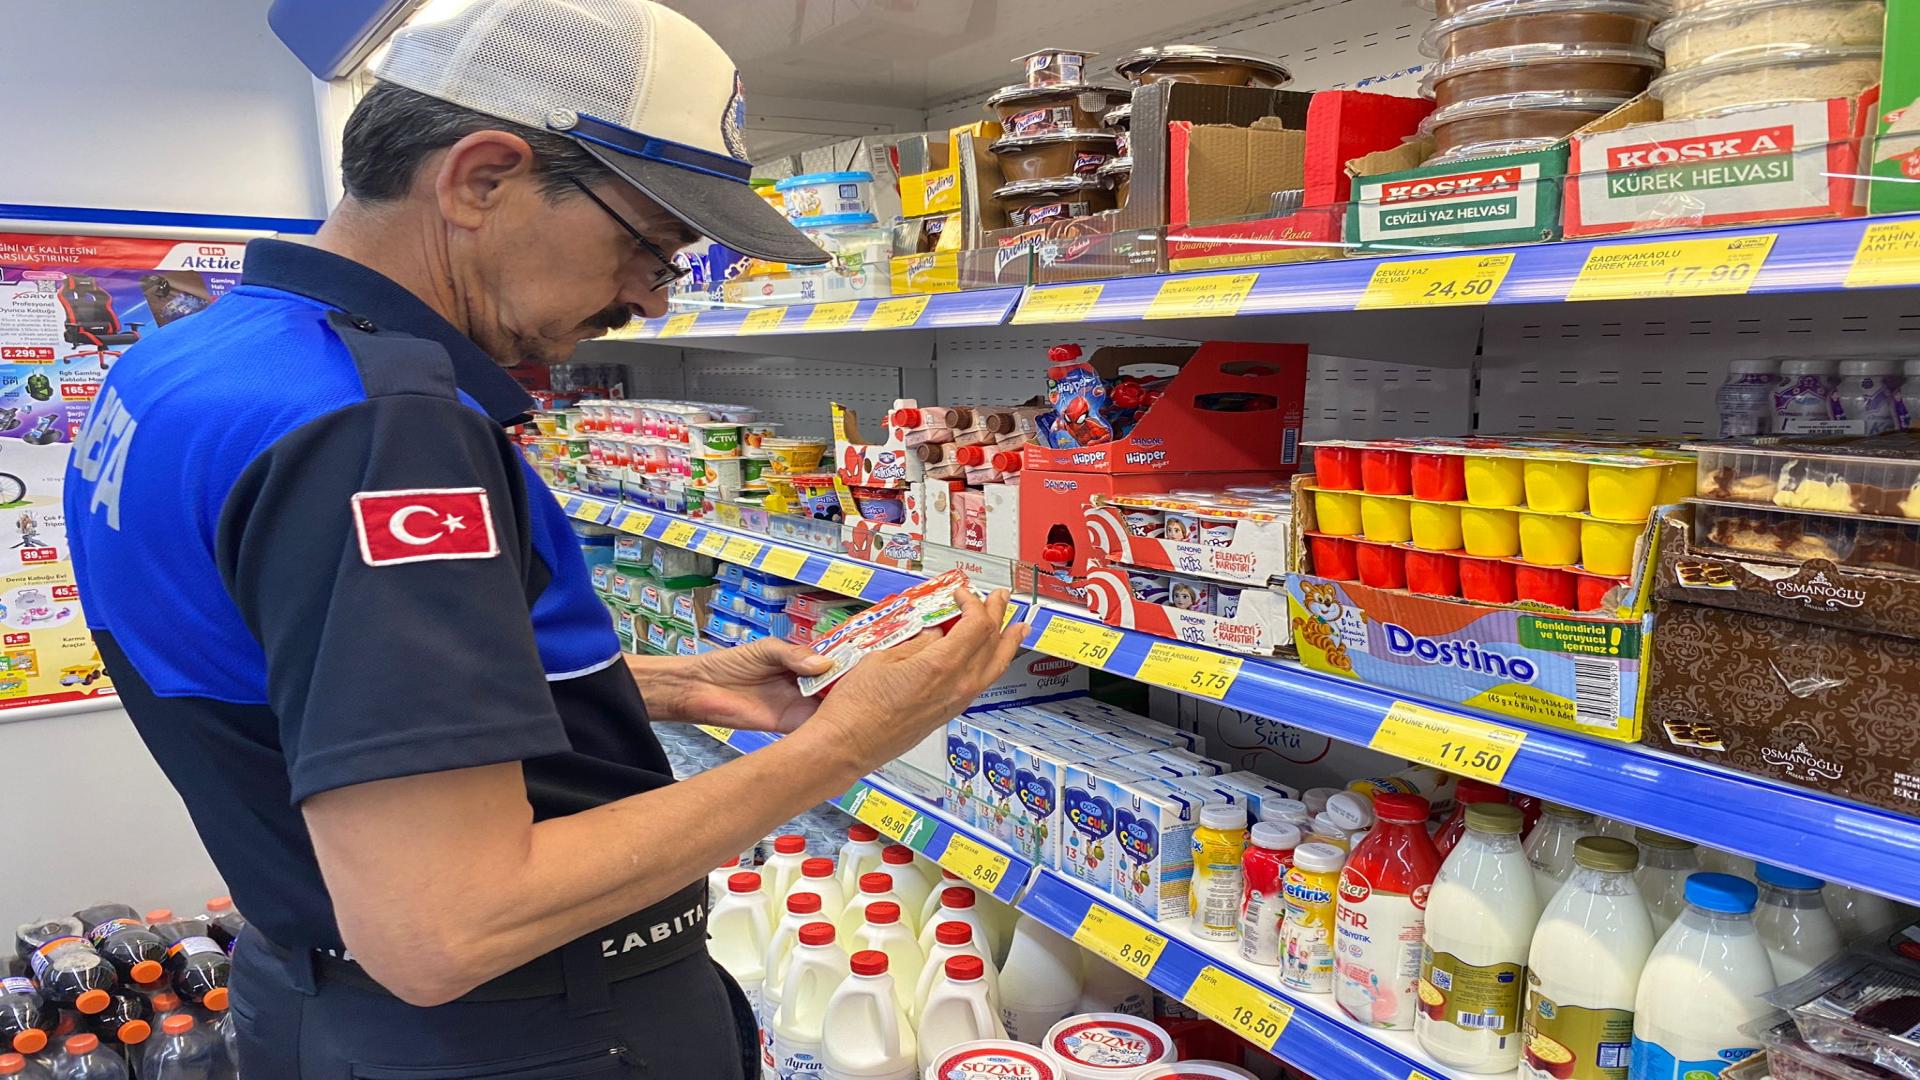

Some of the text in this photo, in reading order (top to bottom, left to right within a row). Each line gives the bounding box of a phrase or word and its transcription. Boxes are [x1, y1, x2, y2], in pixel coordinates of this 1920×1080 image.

[1017, 111, 1043, 130] Puding
[1616, 135, 1781, 168] KOSKA
[1612, 159, 1788, 195] KÜREK HELVASI
[927, 175, 954, 200] Puding
[1386, 175, 1511, 201] KOSKA
[1030, 205, 1058, 223] Puding
[1385, 204, 1510, 226] CEVİZLİ YAZ HELVASI
[1281, 227, 1312, 241] Pasta
[1867, 232, 1914, 243] TAHİN
[39, 246, 97, 256] KALİTESİNİ
[201, 246, 224, 256] BİM
[999, 232, 1042, 269] Puding
[1589, 250, 1681, 263] SADE/KAKAOLU
[1863, 243, 1899, 252] ANT.
[181, 256, 241, 270] Aktüe
[1627, 259, 1665, 269] HELVA
[1376, 268, 1409, 277] CEVİZLİ
[1664, 264, 1750, 287] 17,90
[1424, 279, 1493, 299] 24,50
[899, 311, 920, 322] 3,25
[708, 435, 738, 443] ACTIVI
[1072, 450, 1106, 466] Hüpper
[1126, 450, 1166, 465] Hüpper
[874, 464, 905, 479] Milkshake
[1044, 479, 1078, 490] DANONE
[885, 546, 917, 560] Milkshake
[956, 561, 984, 573] 12 Adet
[1776, 581, 1866, 601] OSMANOĞLU
[1535, 620, 1605, 635] Renklendirici
[1540, 631, 1606, 645] ve koruyucu
[1079, 641, 1108, 659] 7,50
[1384, 622, 1536, 683] Dostino
[1563, 641, 1606, 654] içermez
[1190, 671, 1229, 689] 5,75
[1487, 693, 1499, 703] (45
[1515, 700, 1520, 708] 6
[1546, 707, 1556, 717] 16
[1557, 710, 1574, 721] Adet
[1388, 714, 1449, 734] BÜYÜME KÜPÜ
[1254, 726, 1302, 748] Sütü
[950, 753, 975, 772] Çocuk
[1440, 742, 1502, 772] 11,50
[1761, 747, 1844, 774] OSMANOĞLU
[988, 770, 1014, 790] Çocuk
[1894, 772, 1911, 781] NET
[1020, 789, 1050, 812] Çocuk
[1894, 787, 1920, 801] EKL
[881, 815, 905, 834] 49,90
[1071, 809, 1108, 832] Çocuk
[1120, 831, 1153, 855] Çocuk
[1066, 846, 1077, 859] 13
[974, 864, 998, 883] 8,90
[1337, 904, 1368, 930] EFİR
[602, 903, 704, 957] ZABITA
[1120, 943, 1151, 967] 8,90
[1200, 973, 1217, 986] KEFİR
[1232, 1006, 1278, 1039] 18,50
[1080, 1031, 1145, 1051] SÜZME
[784, 1055, 824, 1071] Ayran
[961, 1062, 1031, 1077] SÜZME
